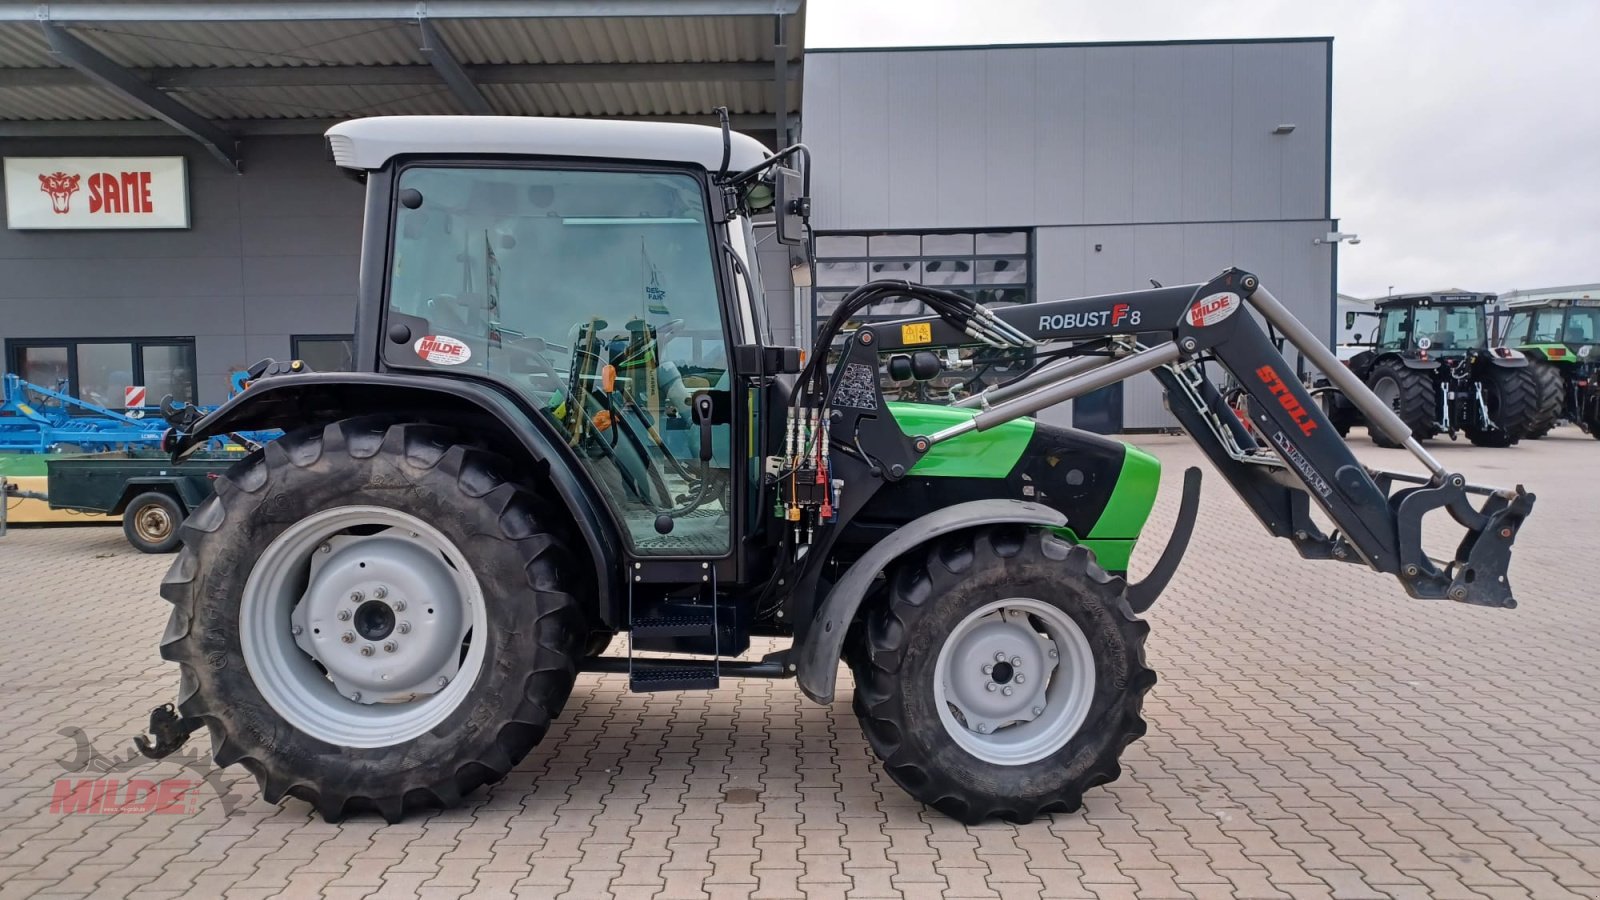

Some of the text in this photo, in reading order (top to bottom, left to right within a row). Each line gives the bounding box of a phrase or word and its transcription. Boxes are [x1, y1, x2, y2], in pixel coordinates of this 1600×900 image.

[88, 172, 153, 213] SAME
[1038, 303, 1141, 331] ROBUST F 8
[1191, 295, 1230, 321] MILDE
[420, 340, 462, 356] MILDE
[1256, 365, 1318, 437] STOLL
